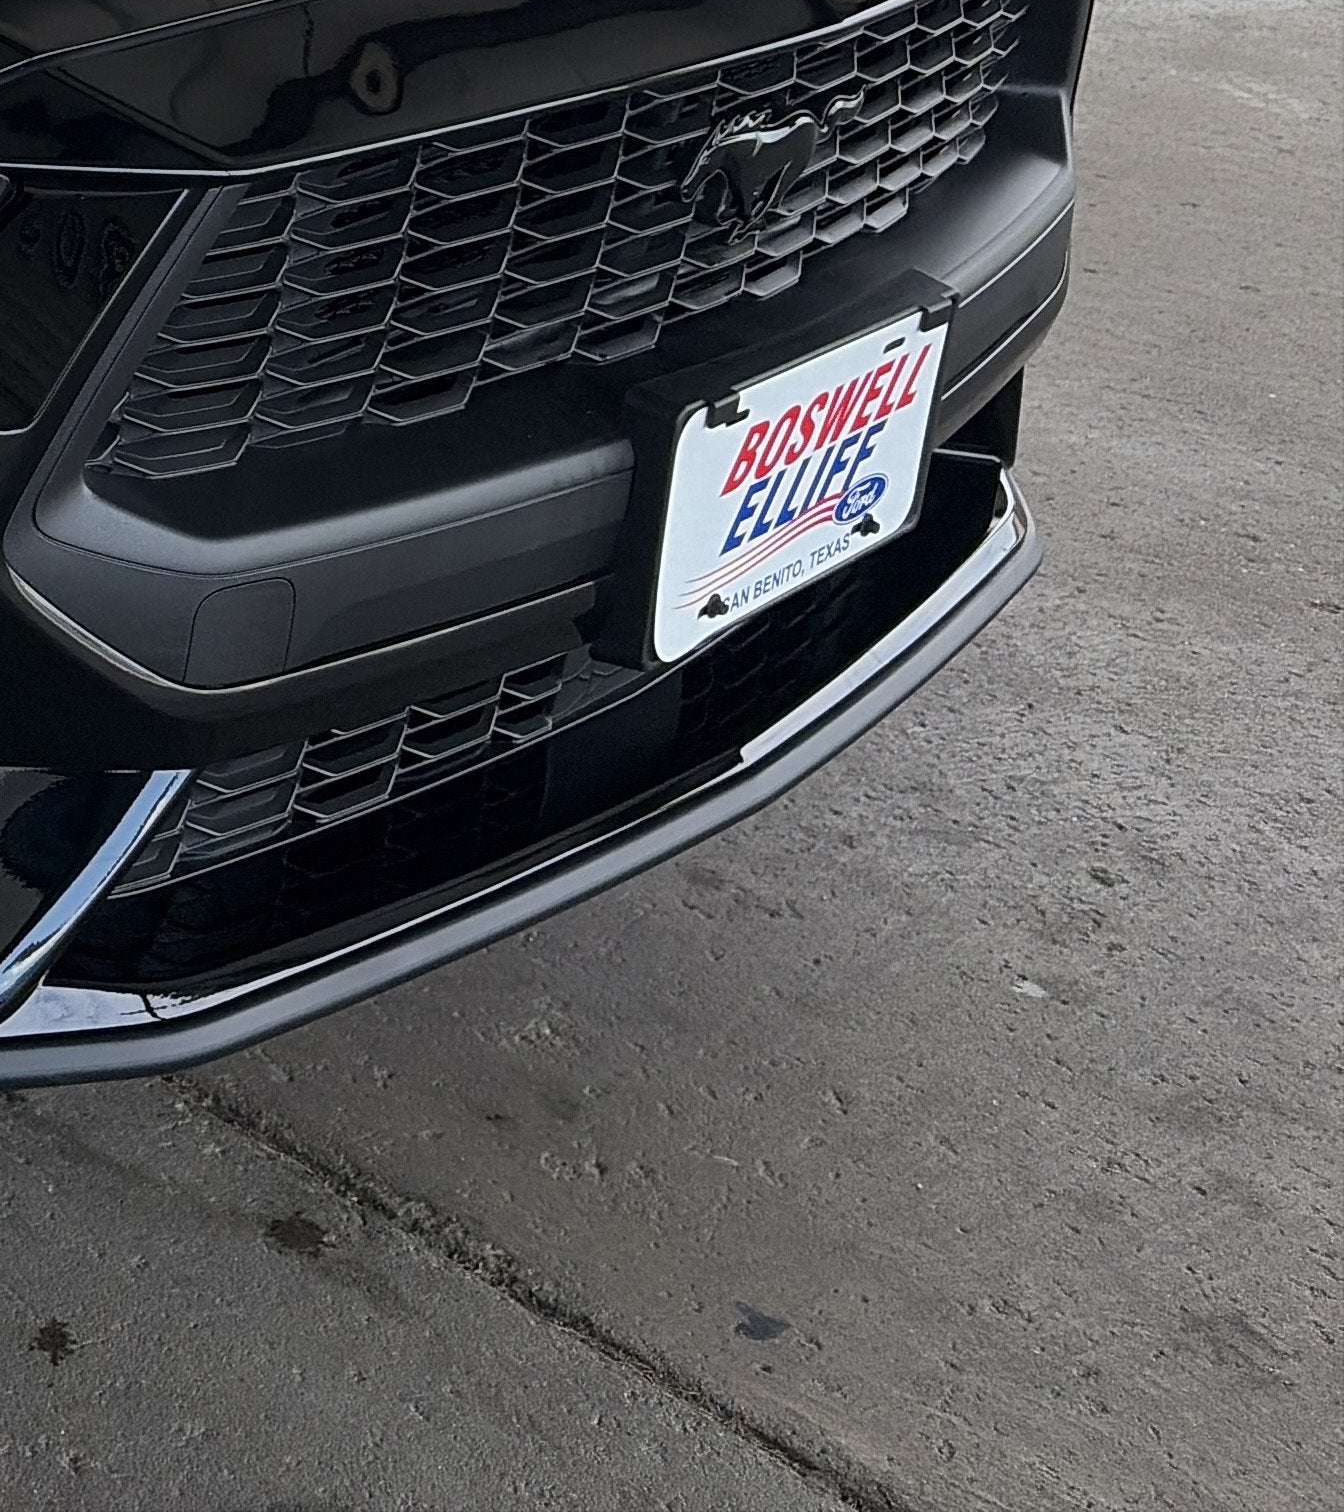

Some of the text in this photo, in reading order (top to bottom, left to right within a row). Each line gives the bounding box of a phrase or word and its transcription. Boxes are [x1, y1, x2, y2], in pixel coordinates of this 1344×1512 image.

[719, 343, 932, 498] BOSWELL
[719, 418, 889, 557] ELLIFF
[753, 559, 805, 600] BENITO,
[810, 533, 850, 569] TEXAS
